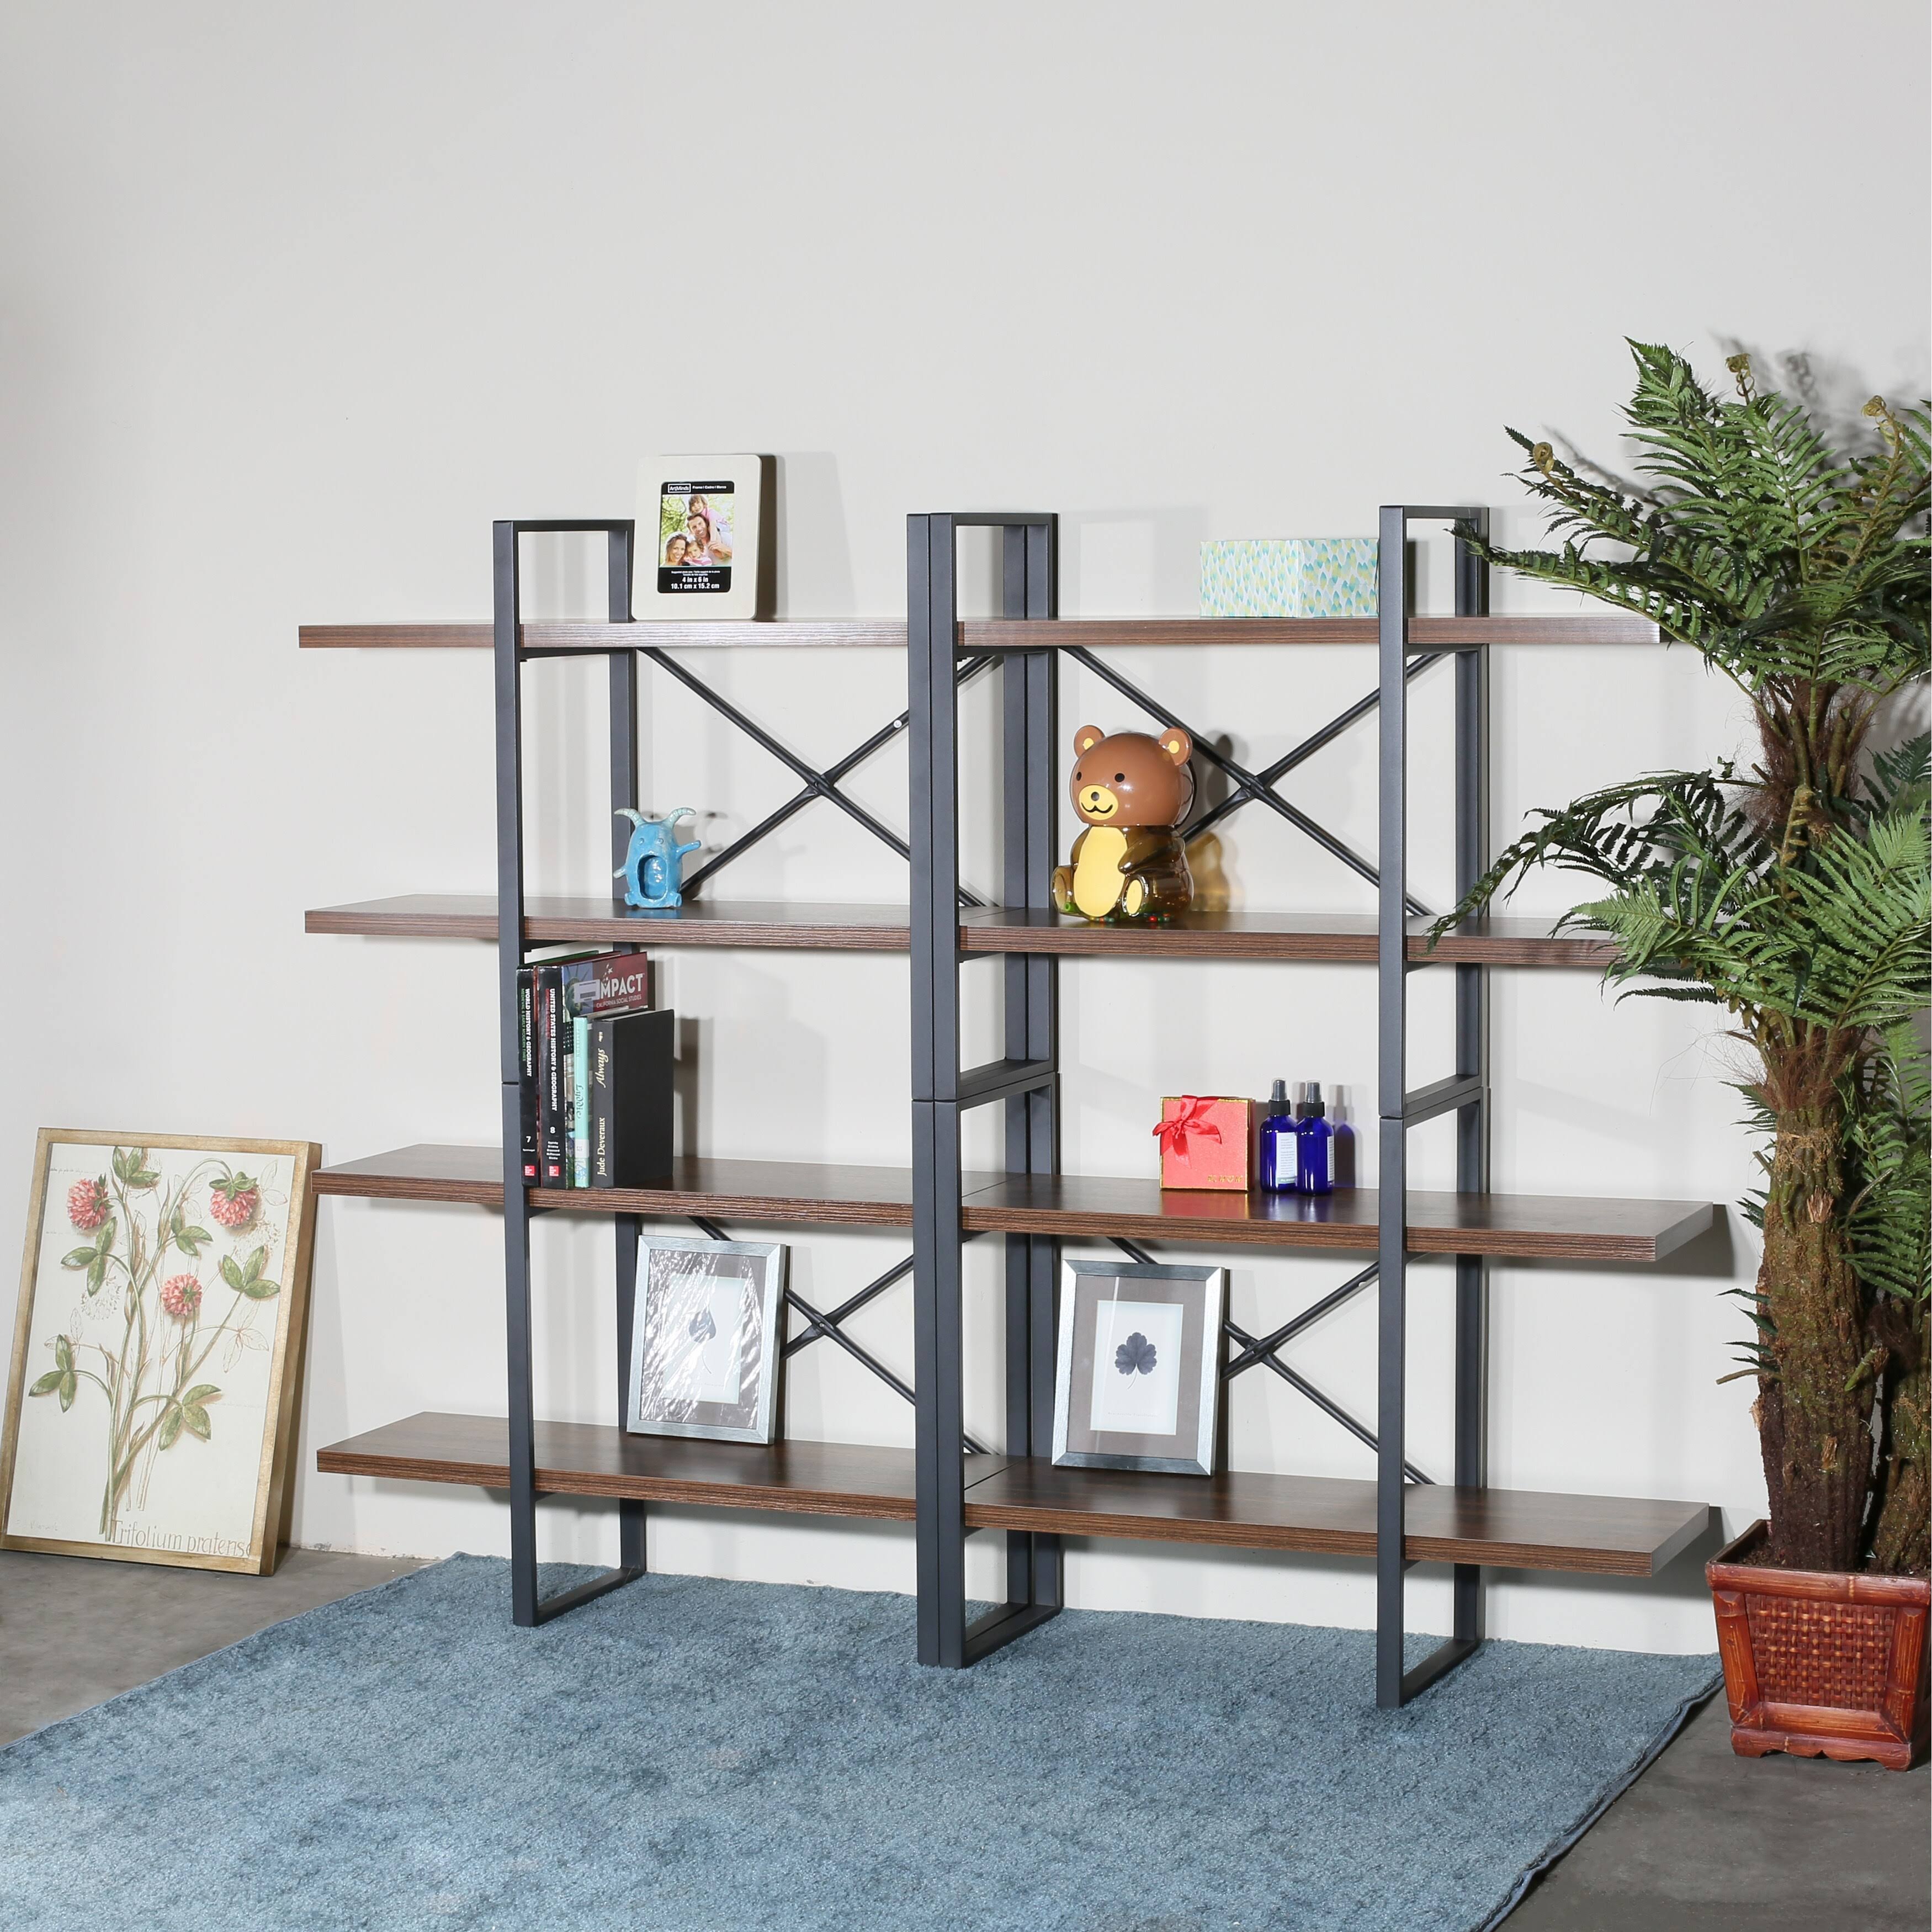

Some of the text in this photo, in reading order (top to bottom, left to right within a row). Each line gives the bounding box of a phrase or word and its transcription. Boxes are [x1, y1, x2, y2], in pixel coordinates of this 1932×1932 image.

[601, 973, 643, 999] MPACT
[596, 999, 616, 1008] CALIFORNIA
[595, 1048, 608, 1088] Always
[597, 1117, 607, 1176] Jude Deveraux
[111, 1519, 182, 1550] Trifolium
